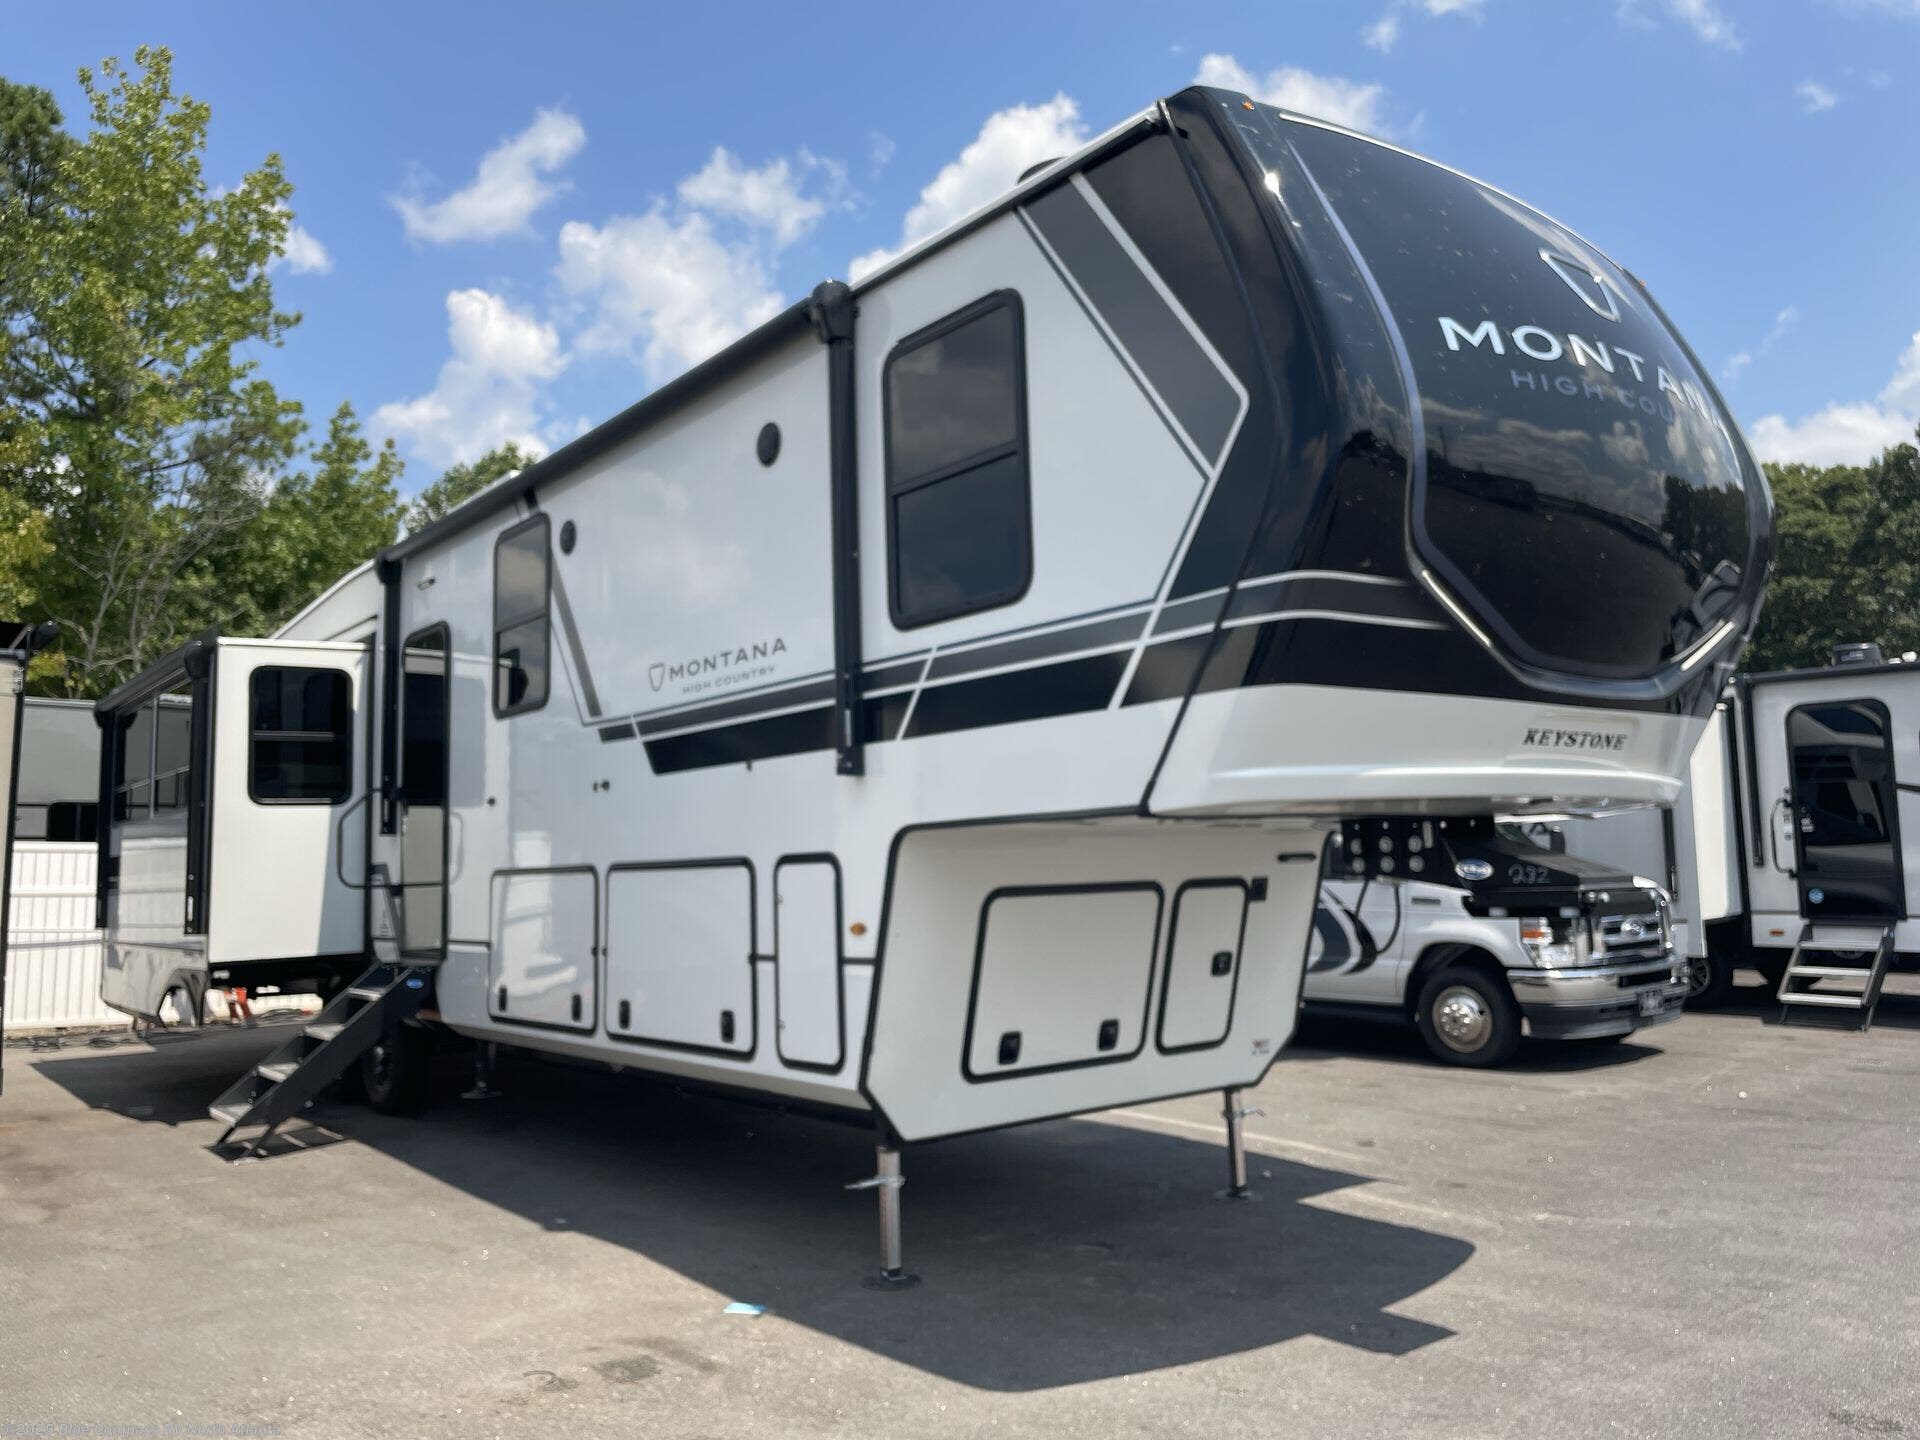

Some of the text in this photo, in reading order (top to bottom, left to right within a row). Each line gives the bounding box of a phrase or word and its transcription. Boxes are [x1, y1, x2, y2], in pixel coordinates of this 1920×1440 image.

[1511, 368, 1606, 402] HIGH
[669, 637, 787, 681] MONTANA
[682, 665, 775, 695] HIGH COUNTRY
[1522, 727, 1628, 751] KEYSTONE
